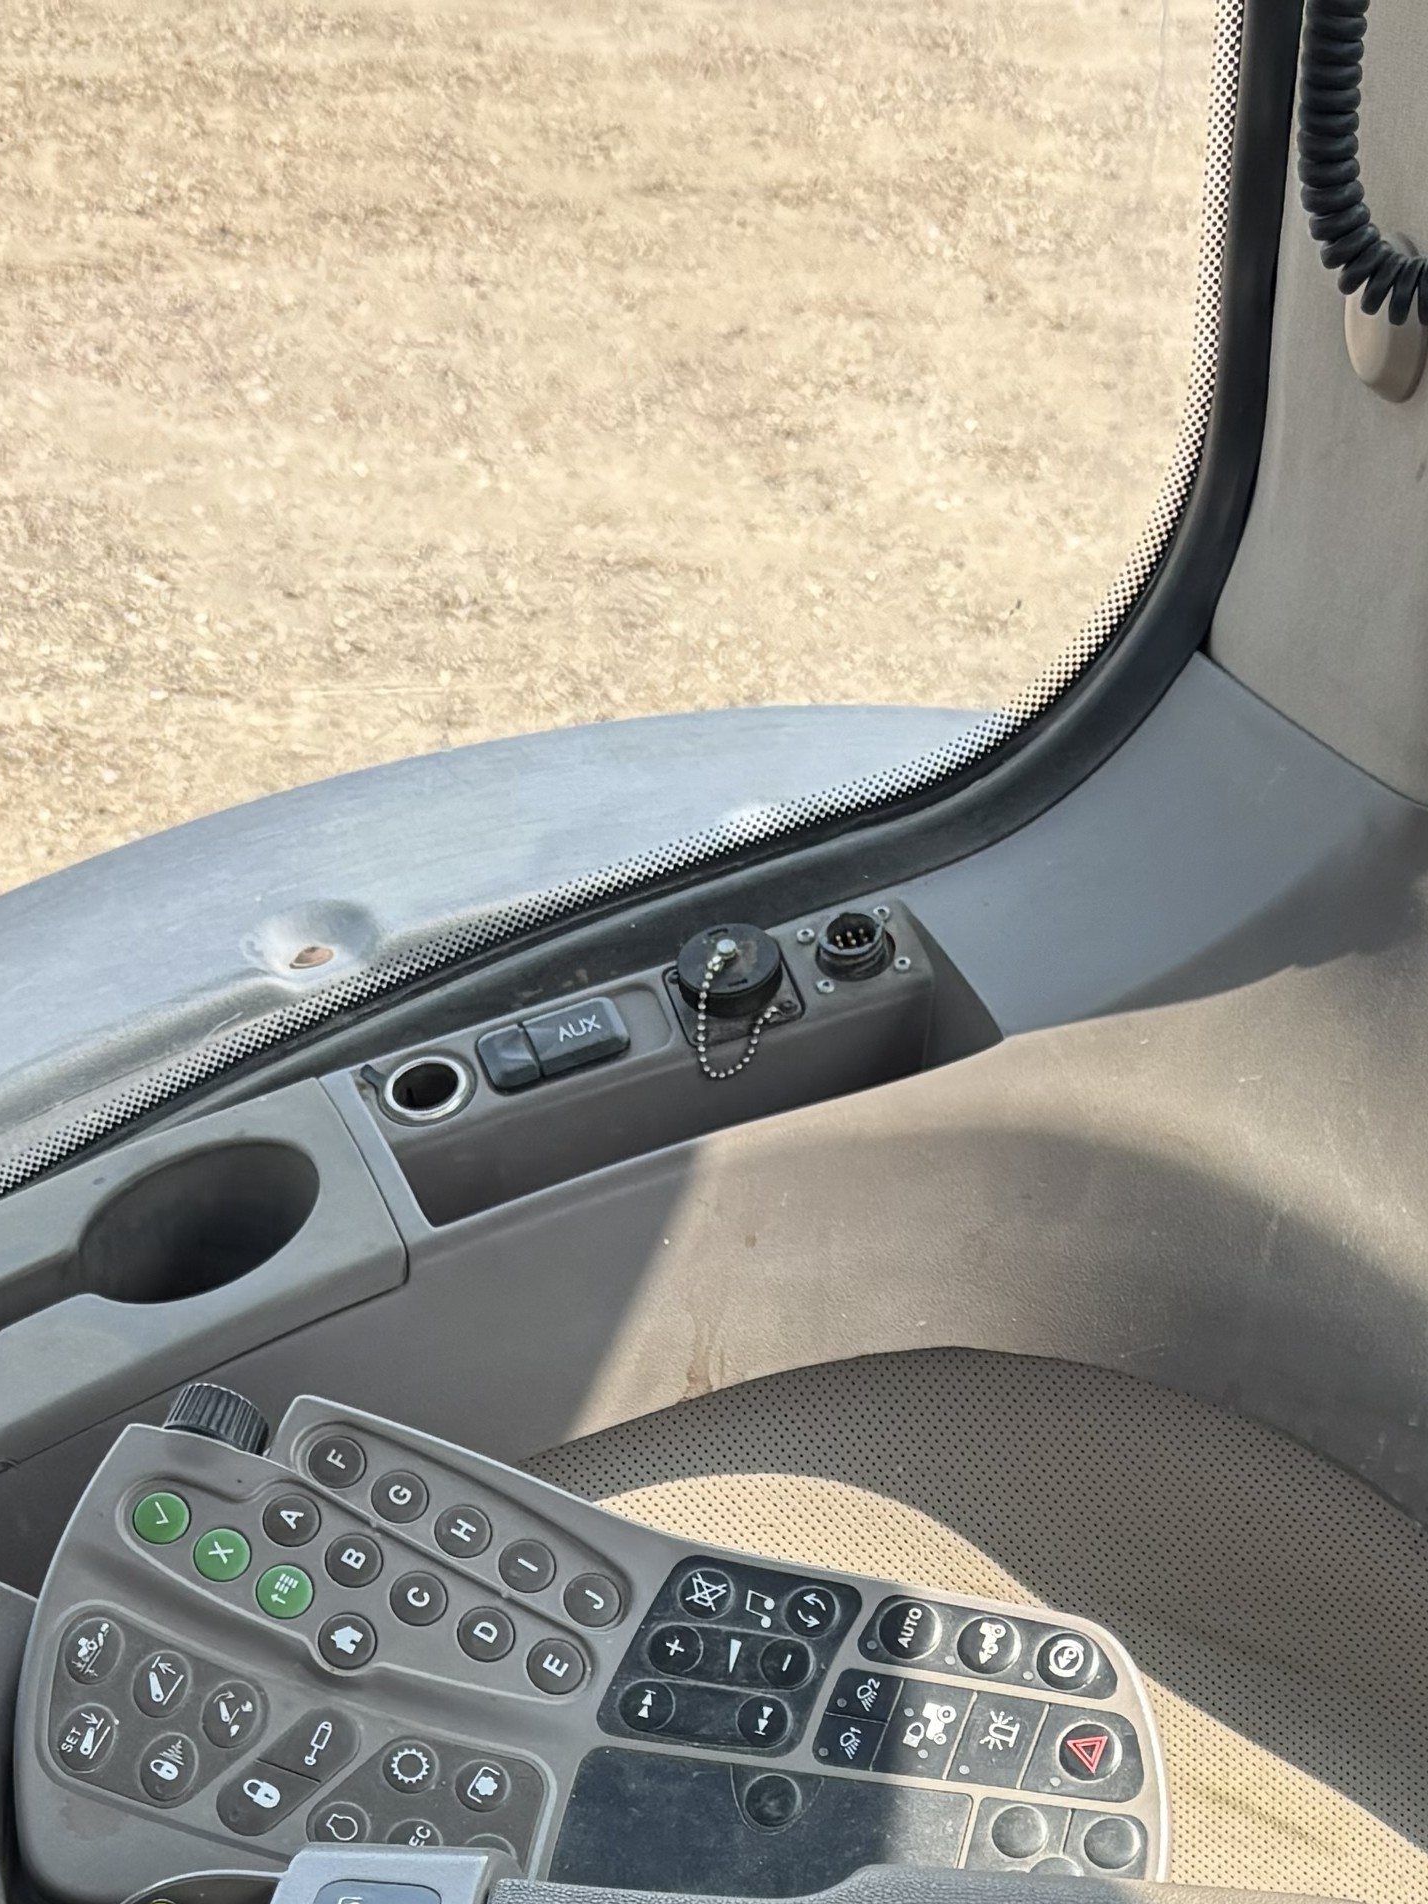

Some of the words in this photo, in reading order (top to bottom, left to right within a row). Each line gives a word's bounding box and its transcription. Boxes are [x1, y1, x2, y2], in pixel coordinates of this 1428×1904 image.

[558, 1014, 602, 1042] AUX
[327, 1448, 346, 1470] F
[388, 1484, 412, 1505] G
[279, 1509, 305, 1530] A
[451, 1518, 477, 1542] H
[340, 1547, 366, 1570] B
[407, 1586, 430, 1608] C
[584, 1588, 605, 1610] J
[473, 1621, 498, 1644] D
[897, 1607, 923, 1649] AUTO
[542, 1653, 569, 1678] E
[61, 1726, 82, 1753] SET
